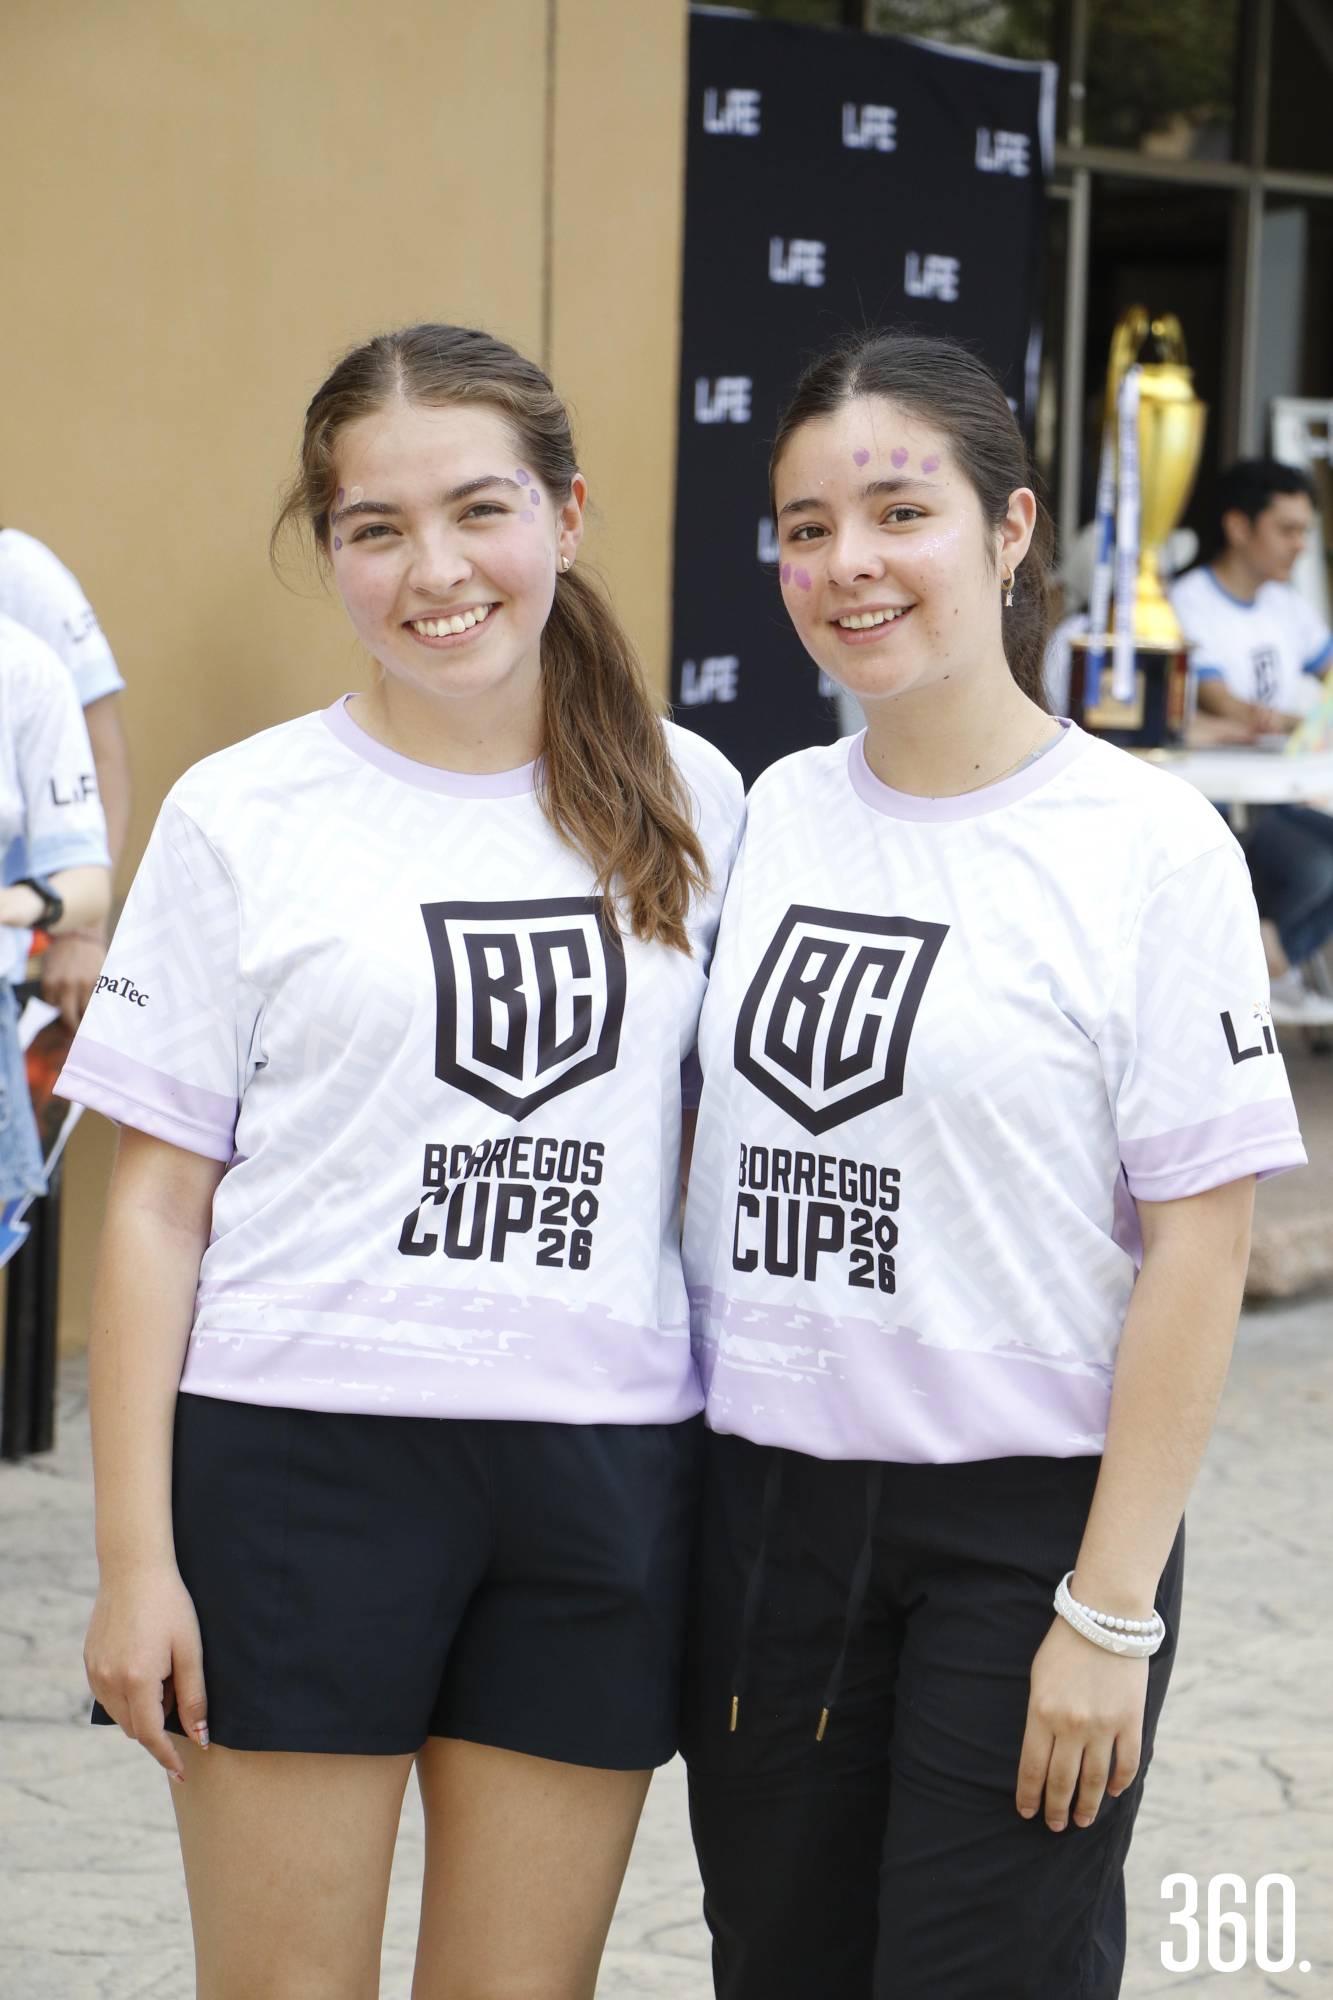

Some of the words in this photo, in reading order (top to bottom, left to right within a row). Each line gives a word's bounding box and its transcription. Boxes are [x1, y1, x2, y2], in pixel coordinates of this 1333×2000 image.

[50, 775, 95, 806] LiF
[96, 975, 149, 1007] paTec
[463, 928, 592, 1081] BC
[764, 936, 906, 1092] BC
[1219, 1004, 1275, 1065] Li
[422, 1136, 605, 1187] BORREGOS
[738, 1142, 901, 1213] BORREGOS
[397, 1182, 537, 1263] CUP
[540, 1187, 600, 1229] 20
[850, 1207, 899, 1254] 20
[536, 1228, 593, 1271] 26
[732, 1191, 846, 1282] CUP
[848, 1249, 897, 1295] 26
